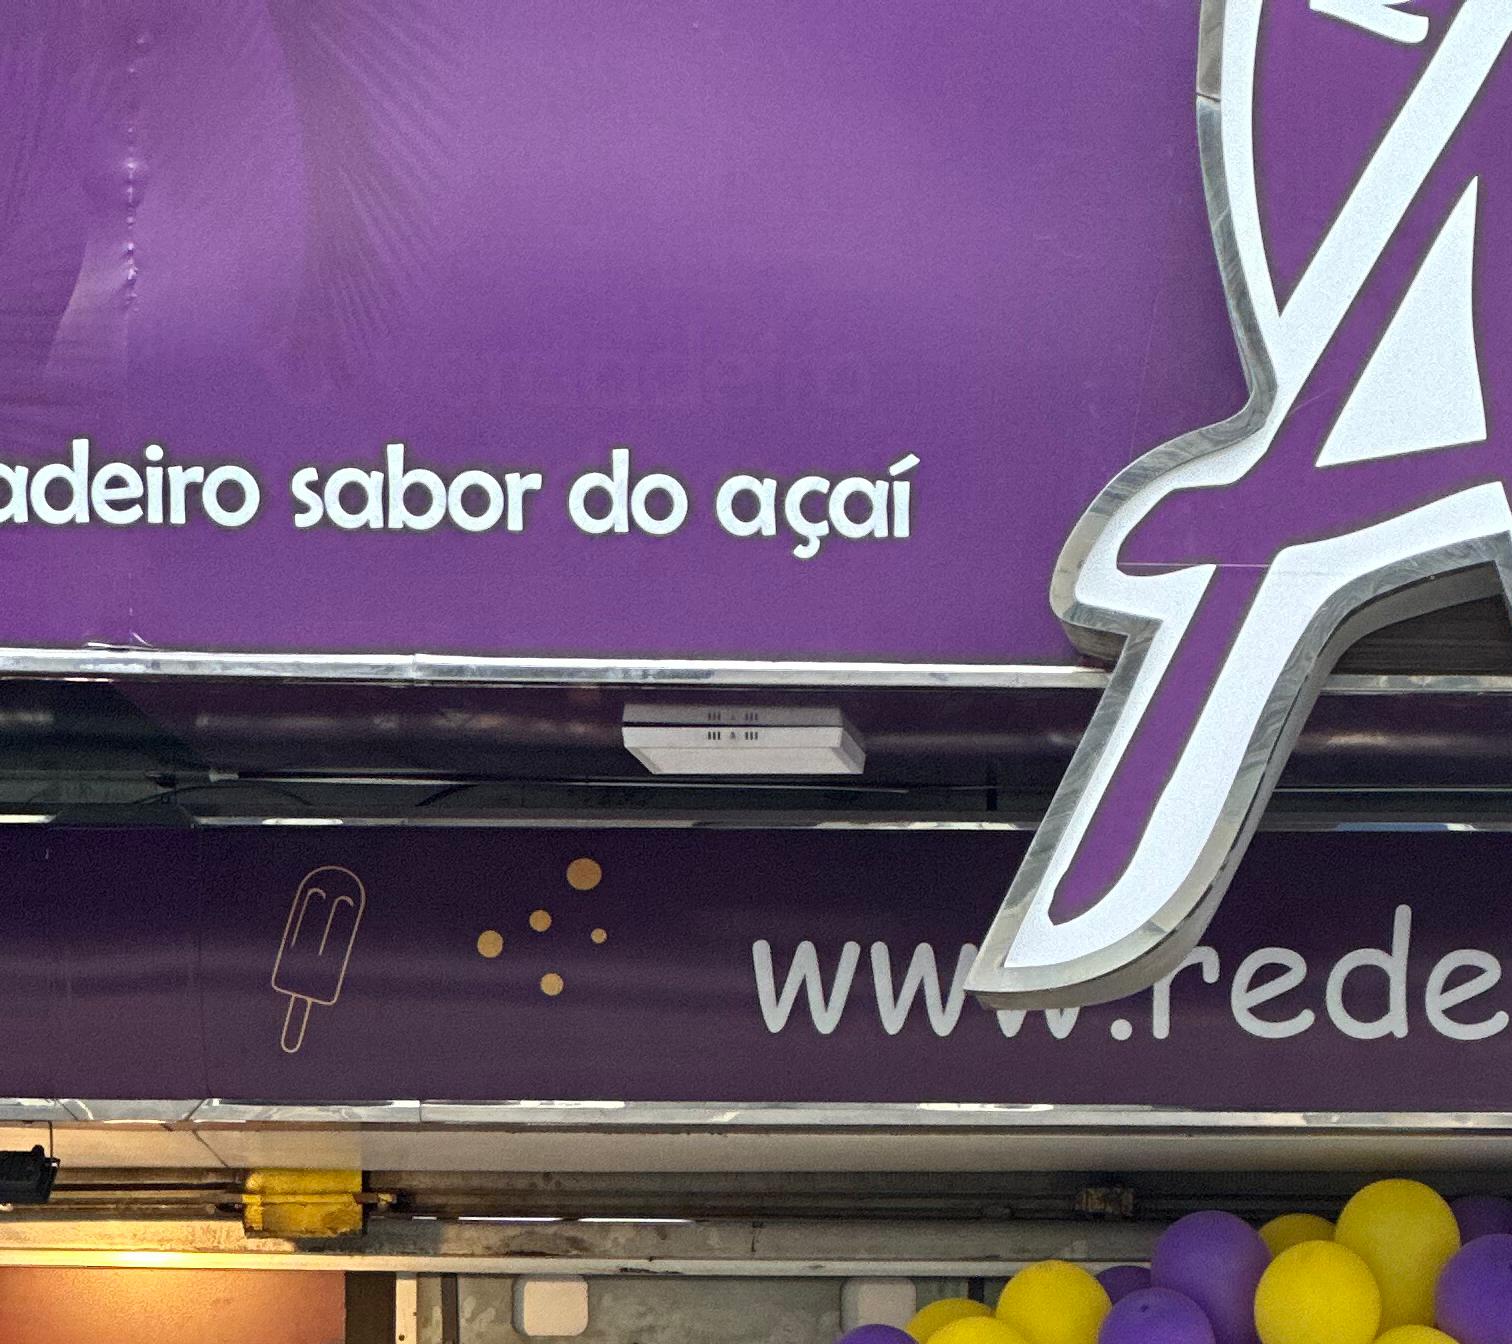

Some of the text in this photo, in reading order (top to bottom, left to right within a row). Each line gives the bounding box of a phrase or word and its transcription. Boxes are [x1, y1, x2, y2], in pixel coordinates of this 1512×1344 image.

[292, 443, 542, 532] sabor
[568, 448, 688, 535] do
[716, 453, 921, 559] açaí
